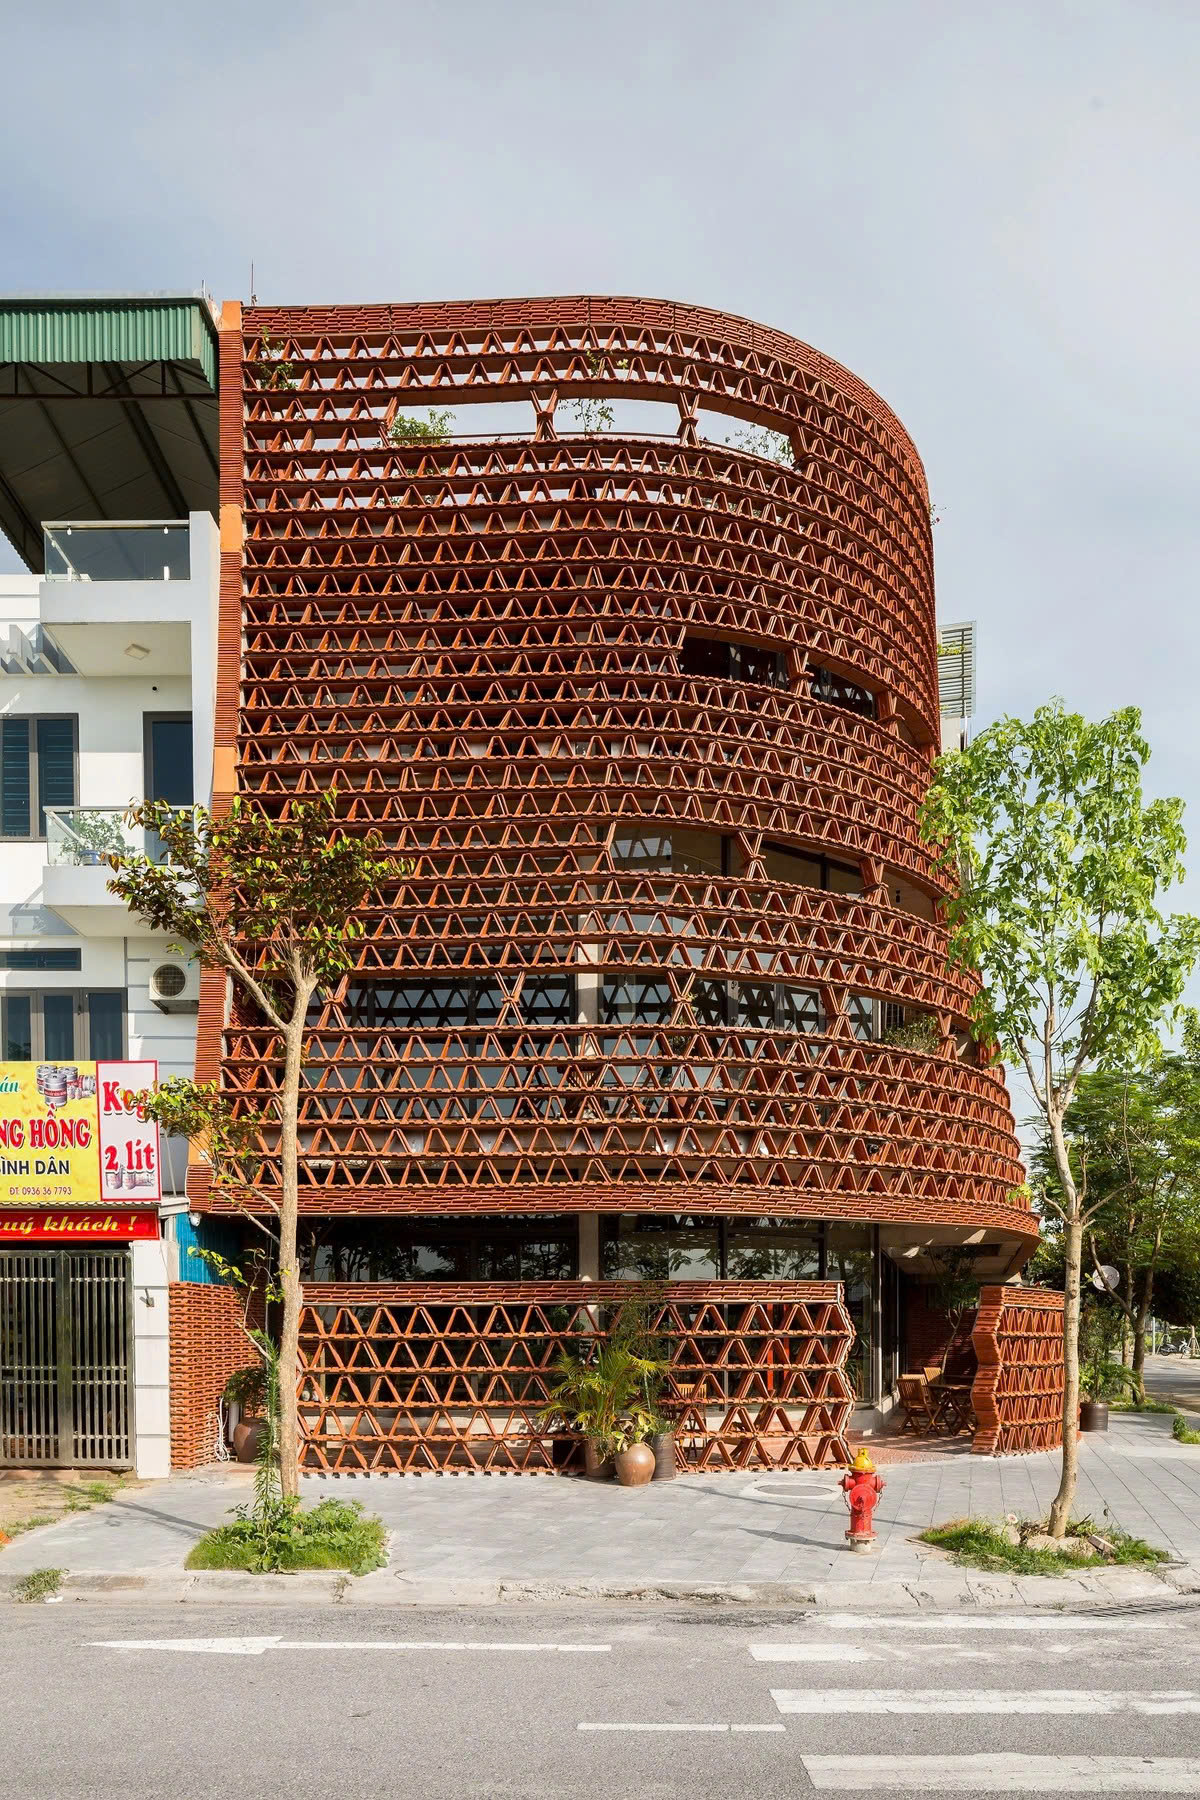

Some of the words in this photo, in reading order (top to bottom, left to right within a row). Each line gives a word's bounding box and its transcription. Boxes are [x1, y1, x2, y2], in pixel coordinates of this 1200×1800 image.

[29, 1103, 91, 1148] HỒNG
[104, 1145, 118, 1171] 2
[126, 1139, 155, 1170] lít
[0, 1156, 29, 1175] ÌNH
[36, 1157, 70, 1175] DÂN
[22, 1186, 41, 1196] 0936
[42, 1186, 52, 1196] 36
[54, 1186, 72, 1196] 7793
[0, 1216, 35, 1235] uý
[43, 1215, 119, 1232] khách
